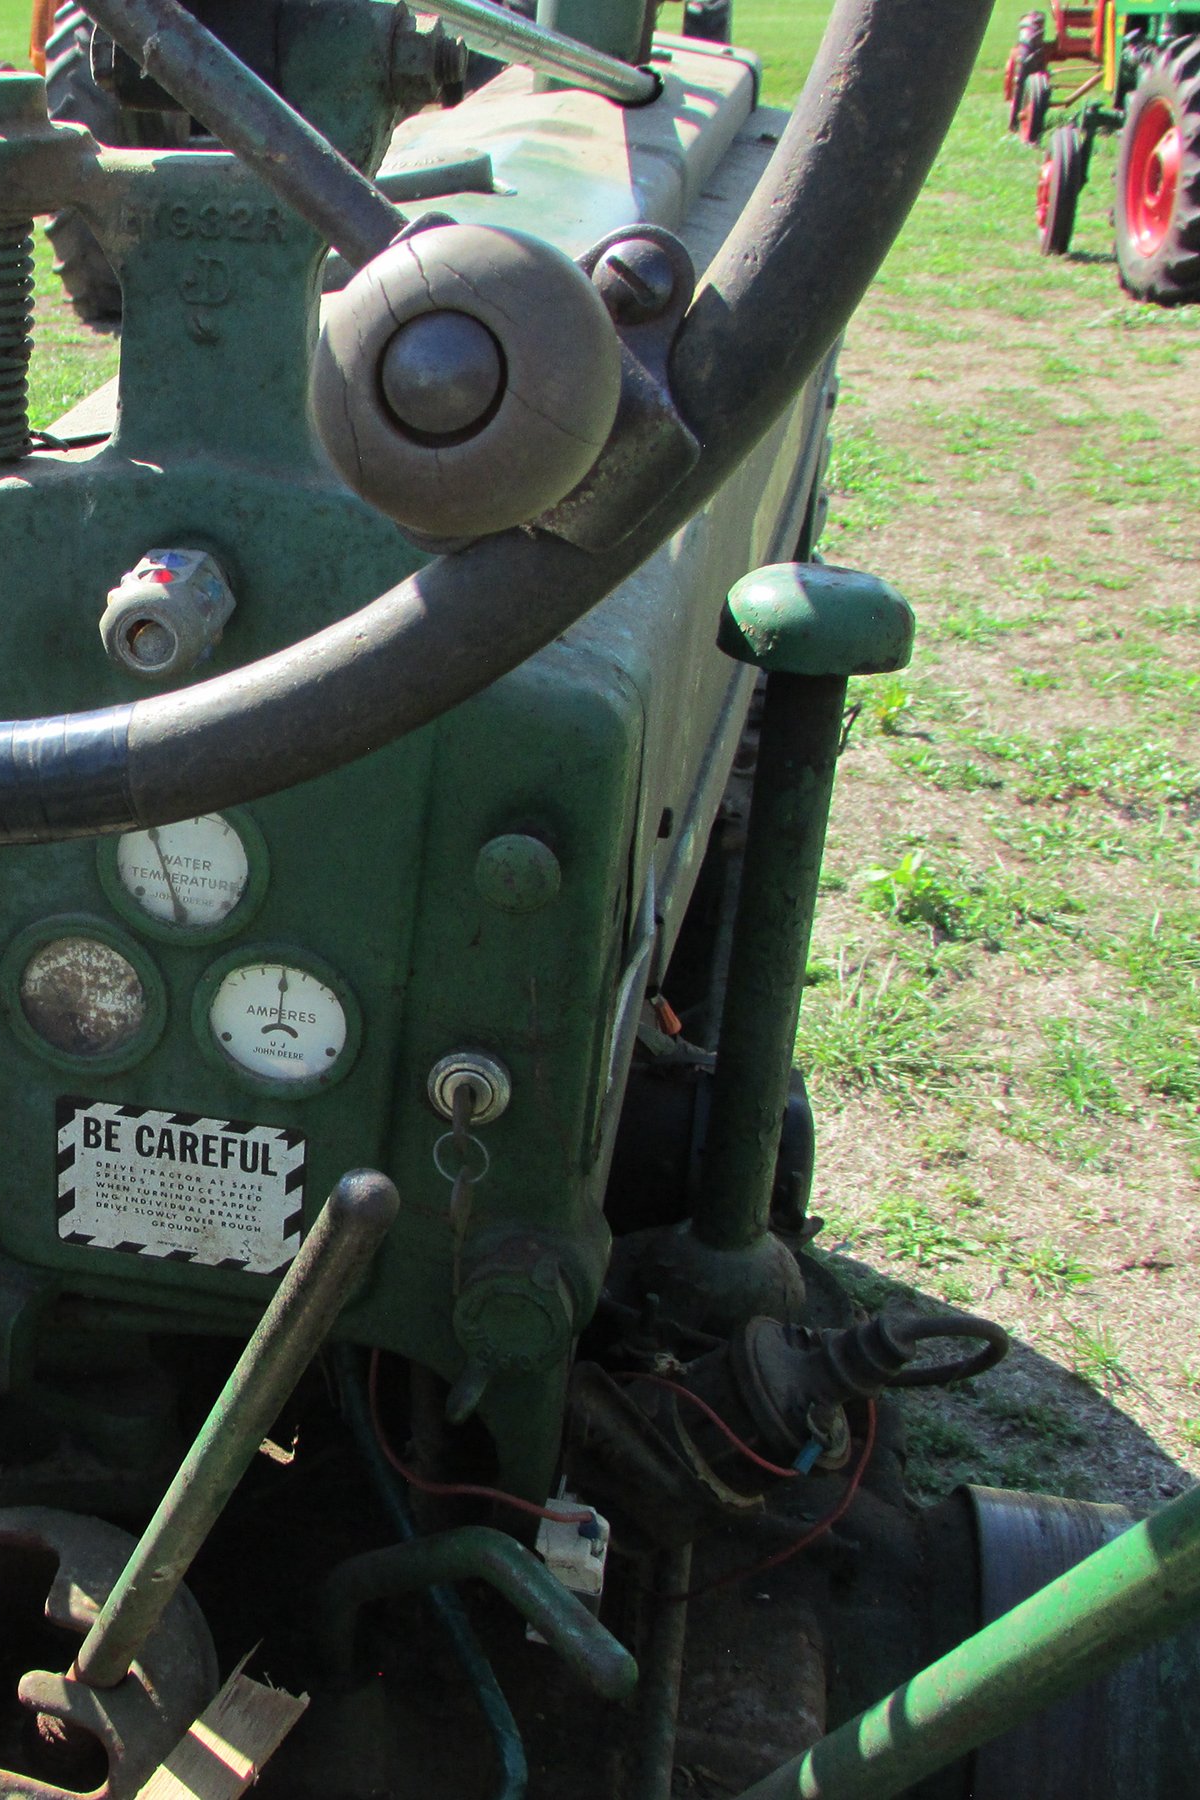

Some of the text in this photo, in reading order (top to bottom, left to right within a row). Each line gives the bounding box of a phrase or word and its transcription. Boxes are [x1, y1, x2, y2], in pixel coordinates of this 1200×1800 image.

[161, 854, 212, 871] WATER
[246, 1005, 316, 1024] AMPERES
[253, 1046, 304, 1060] JOHN DEERE
[83, 1116, 278, 1177] BE CAREFUL
[96, 1161, 262, 1192] DRIVE TRACTOR AT SAFE
[96, 1181, 130, 1192] WHEN
[137, 1188, 192, 1202] TURNING
[200, 1197, 215, 1206] OR
[96, 1191, 119, 1201] ING
[125, 1196, 202, 1214] INDIVIDUAL
[160, 1181, 212, 1195] REDUCE
[221, 1190, 262, 1202] SPEED
[96, 1201, 261, 1233] DRIVE SLOWLY OVER ROUGH
